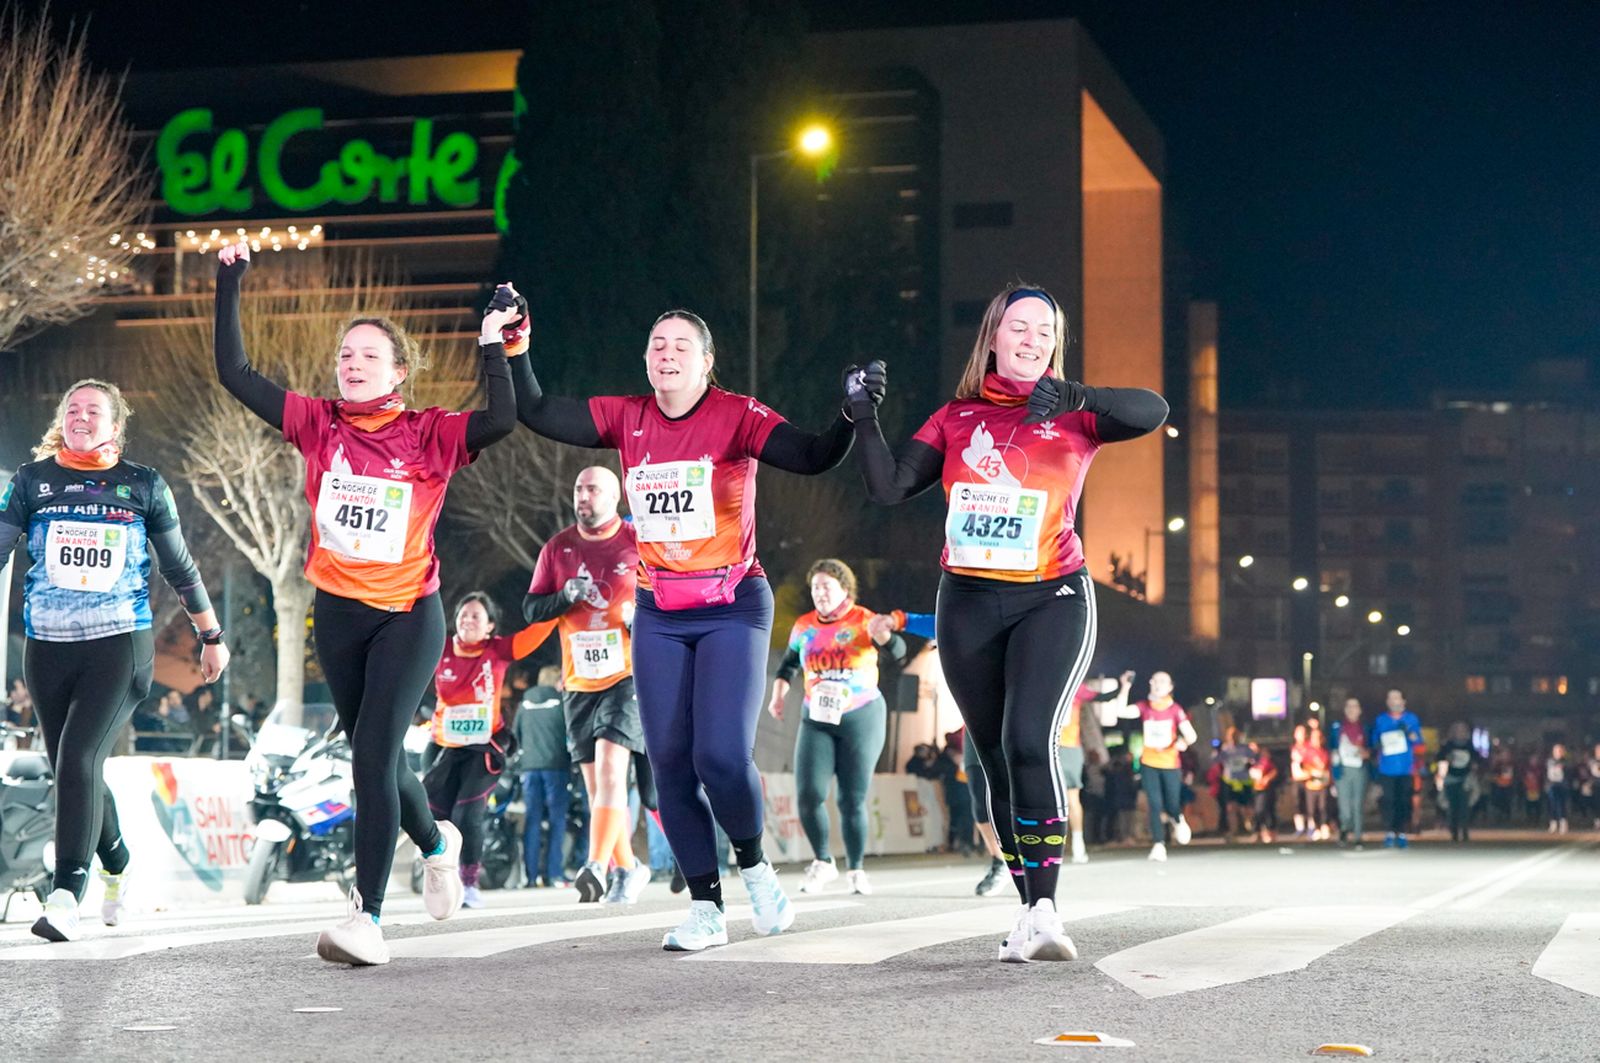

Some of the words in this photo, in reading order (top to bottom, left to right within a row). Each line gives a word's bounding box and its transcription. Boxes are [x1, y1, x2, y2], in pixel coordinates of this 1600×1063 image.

[156, 106, 252, 215] El
[257, 106, 481, 211] Corte
[976, 455, 1001, 477] 43
[645, 472, 668, 480] NOCHE
[669, 470, 679, 479] DE
[341, 484, 368, 494] NOCHE
[367, 486, 377, 496] DE
[635, 481, 651, 492] SAN
[329, 491, 348, 501] SAN
[645, 490, 695, 514] 2212
[971, 493, 996, 504] NOCHE
[998, 496, 1010, 505] DE
[959, 503, 976, 512] SAN
[335, 504, 388, 532] 4512
[961, 513, 1023, 540] 4325
[65, 529, 87, 538] NOCHE
[56, 536, 71, 545] SAN
[60, 545, 112, 568] 6909
[584, 648, 609, 662] 484
[806, 648, 846, 675] HOY
[451, 720, 485, 732] 12372
[194, 796, 233, 829] SAN
